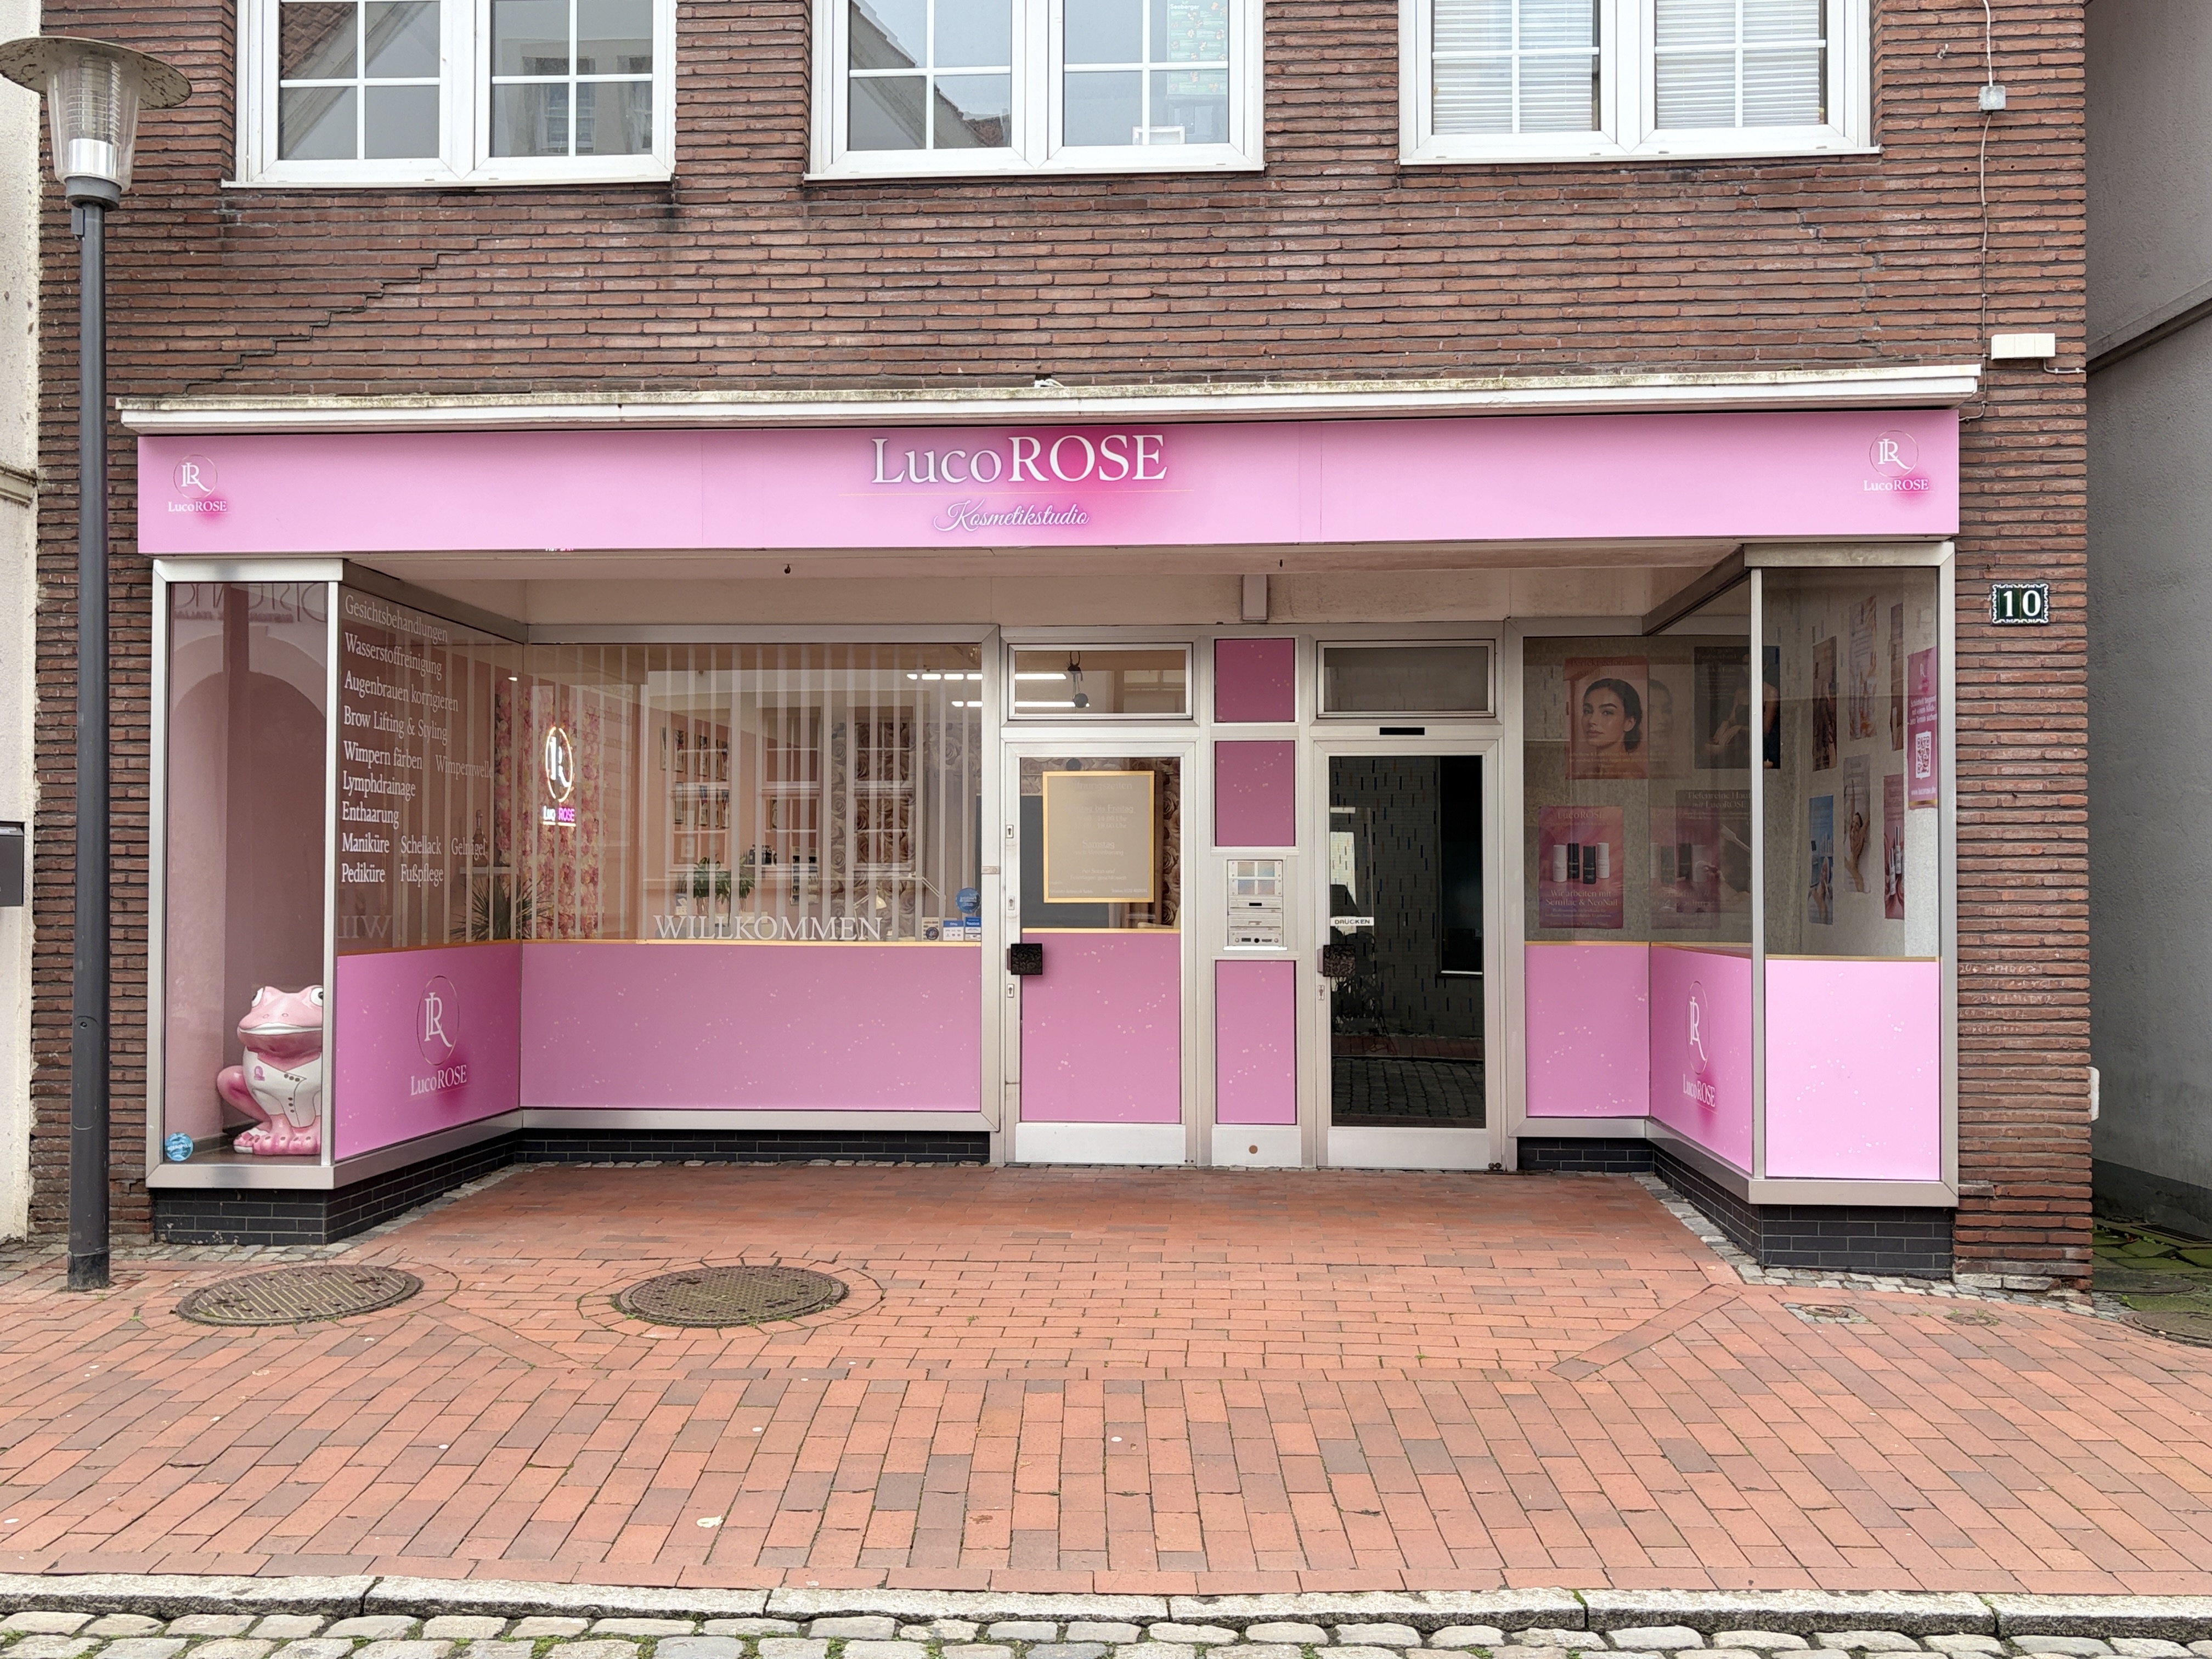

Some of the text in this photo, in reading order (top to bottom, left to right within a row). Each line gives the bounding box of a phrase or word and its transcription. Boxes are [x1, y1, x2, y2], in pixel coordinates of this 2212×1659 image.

[871, 435, 1167, 483] LucoROSE
[1864, 479, 1929, 491] LucoROSE
[168, 501, 227, 511] LucoROSE
[933, 498, 1091, 532] Kosmetikstudio
[2004, 590, 2041, 617] 10
[345, 595, 448, 645] Gesichtsbehandlungen
[345, 632, 442, 680] Wasserstoffreinigung
[344, 670, 459, 713] Augenbrauen korrigieren
[344, 706, 448, 746] Brow Lifting & Styling
[343, 741, 391, 769] Wimpern
[393, 747, 422, 769] färben
[343, 770, 416, 802] Lymphdrainage
[342, 801, 399, 830] Enthaarung
[342, 832, 390, 854] Maniküre
[400, 834, 442, 855] Schellack
[341, 862, 443, 888] Pediküre Fußpflege
[653, 915, 882, 941] WILLKOMMEN
[410, 1064, 467, 1096] LucoROSE
[1683, 1074, 1716, 1107] LucoROSE
